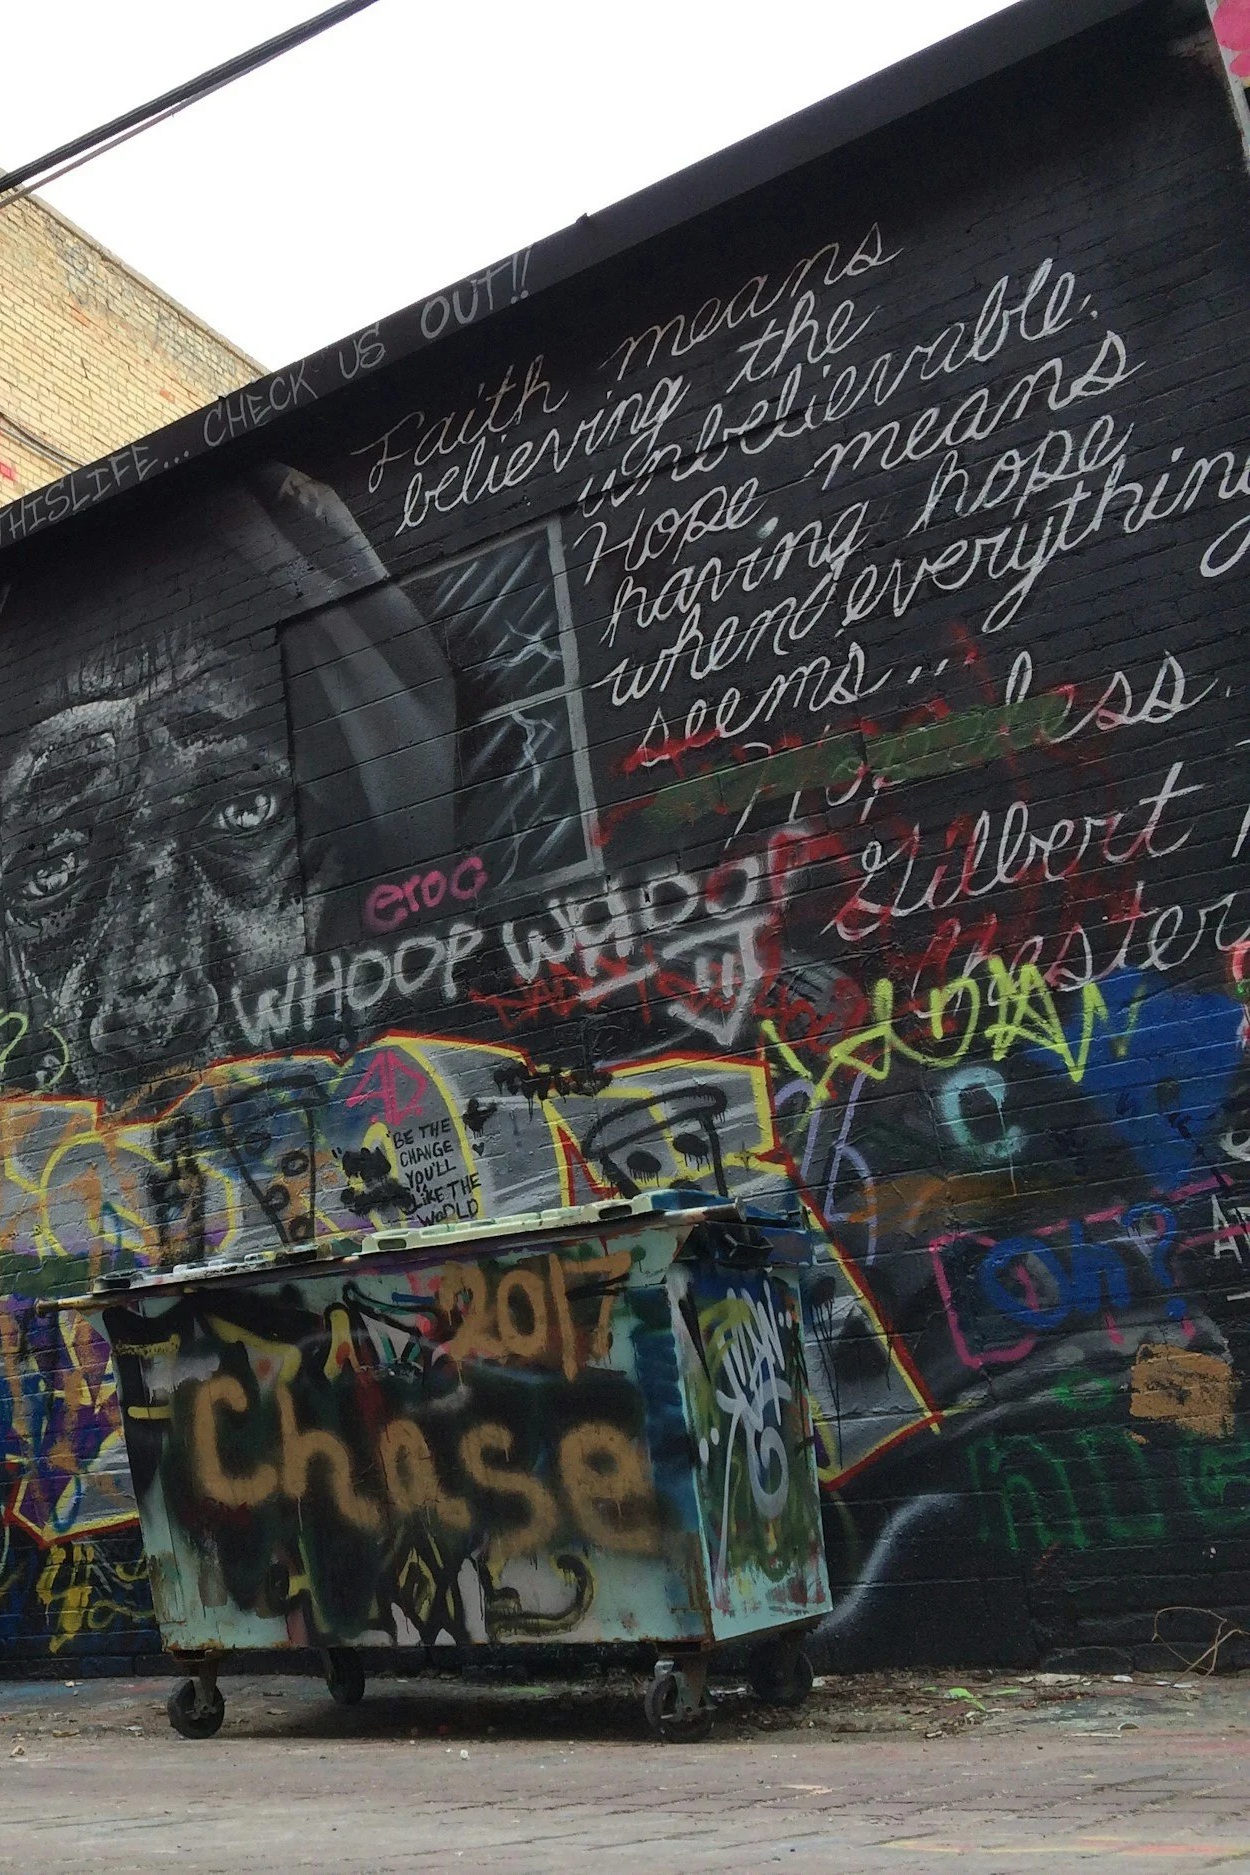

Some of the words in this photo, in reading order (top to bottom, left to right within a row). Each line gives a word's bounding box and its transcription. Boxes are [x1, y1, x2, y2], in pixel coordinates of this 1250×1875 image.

[203, 366, 319, 447] CHECK
[339, 325, 386, 380] US
[350, 354, 569, 493] Faith
[599, 221, 904, 381] means
[393, 375, 691, 538] believing
[726, 289, 882, 394] the
[573, 476, 768, 586] Hope
[806, 329, 1146, 491] means
[600, 497, 875, 648] having
[907, 414, 1135, 538] hope
[592, 595, 815, 707] when
[228, 920, 484, 1047] WHOOP
[399, 1139, 455, 1168] CHANGE
[418, 1117, 452, 1139] THE
[447, 1171, 482, 1199] THE
[192, 1375, 662, 1561] Chase
